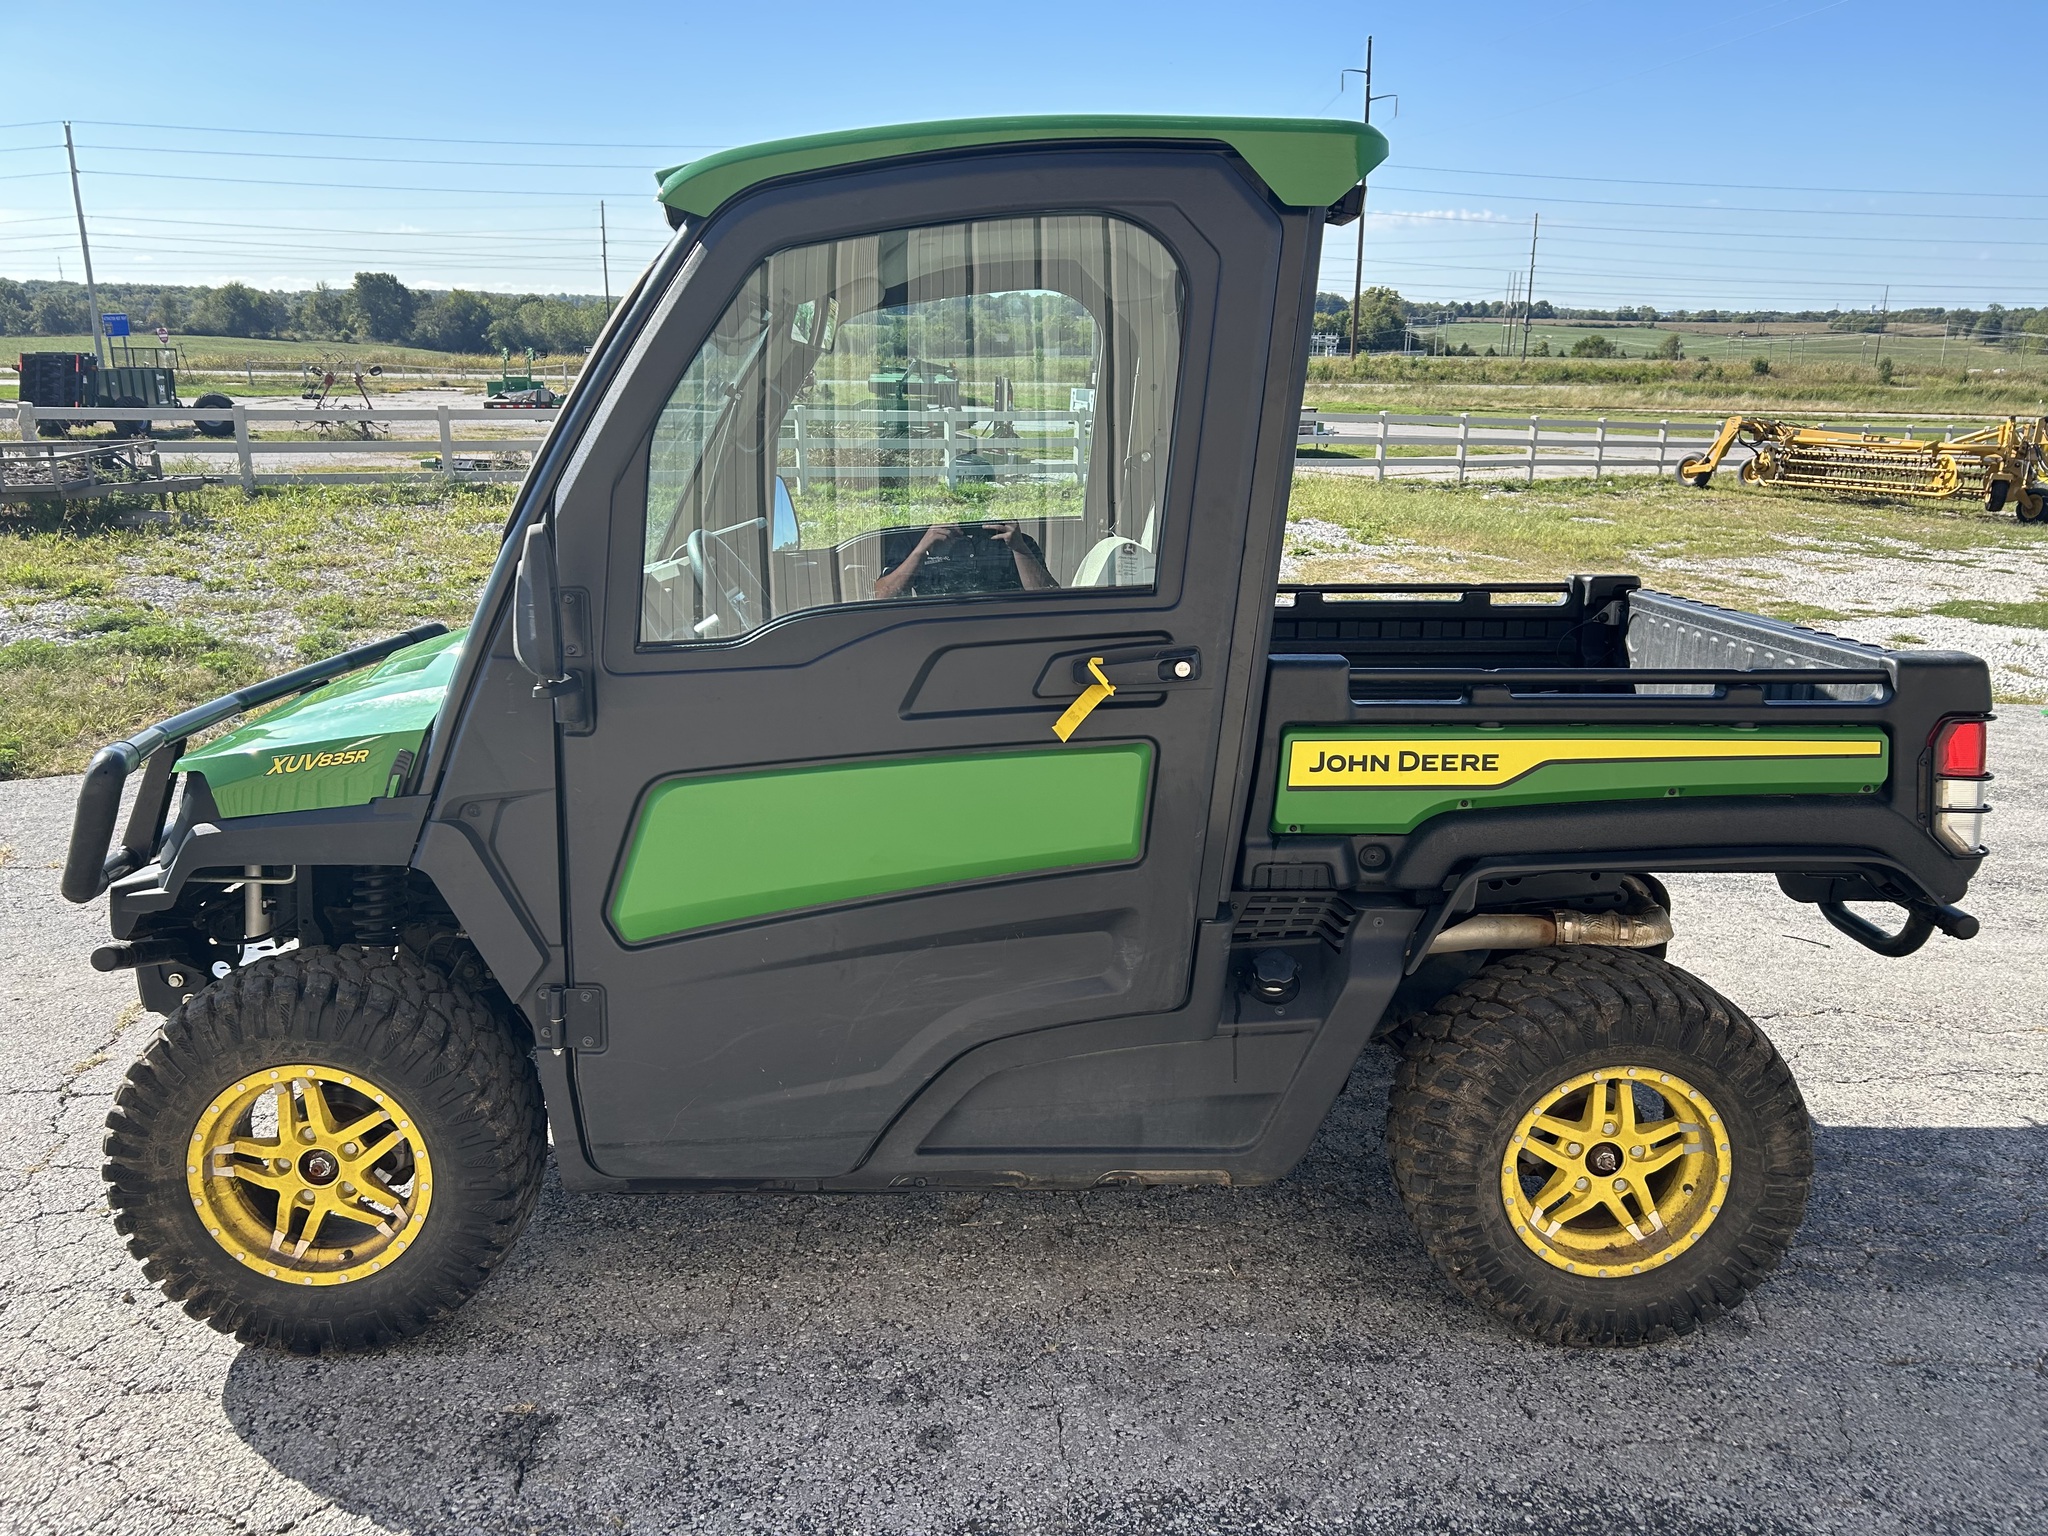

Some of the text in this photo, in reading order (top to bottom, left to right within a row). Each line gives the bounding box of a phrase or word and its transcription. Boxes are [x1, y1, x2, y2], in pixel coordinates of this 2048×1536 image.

[264, 749, 370, 776] XUV835R
[1309, 751, 1499, 772] JOHN DEERE
